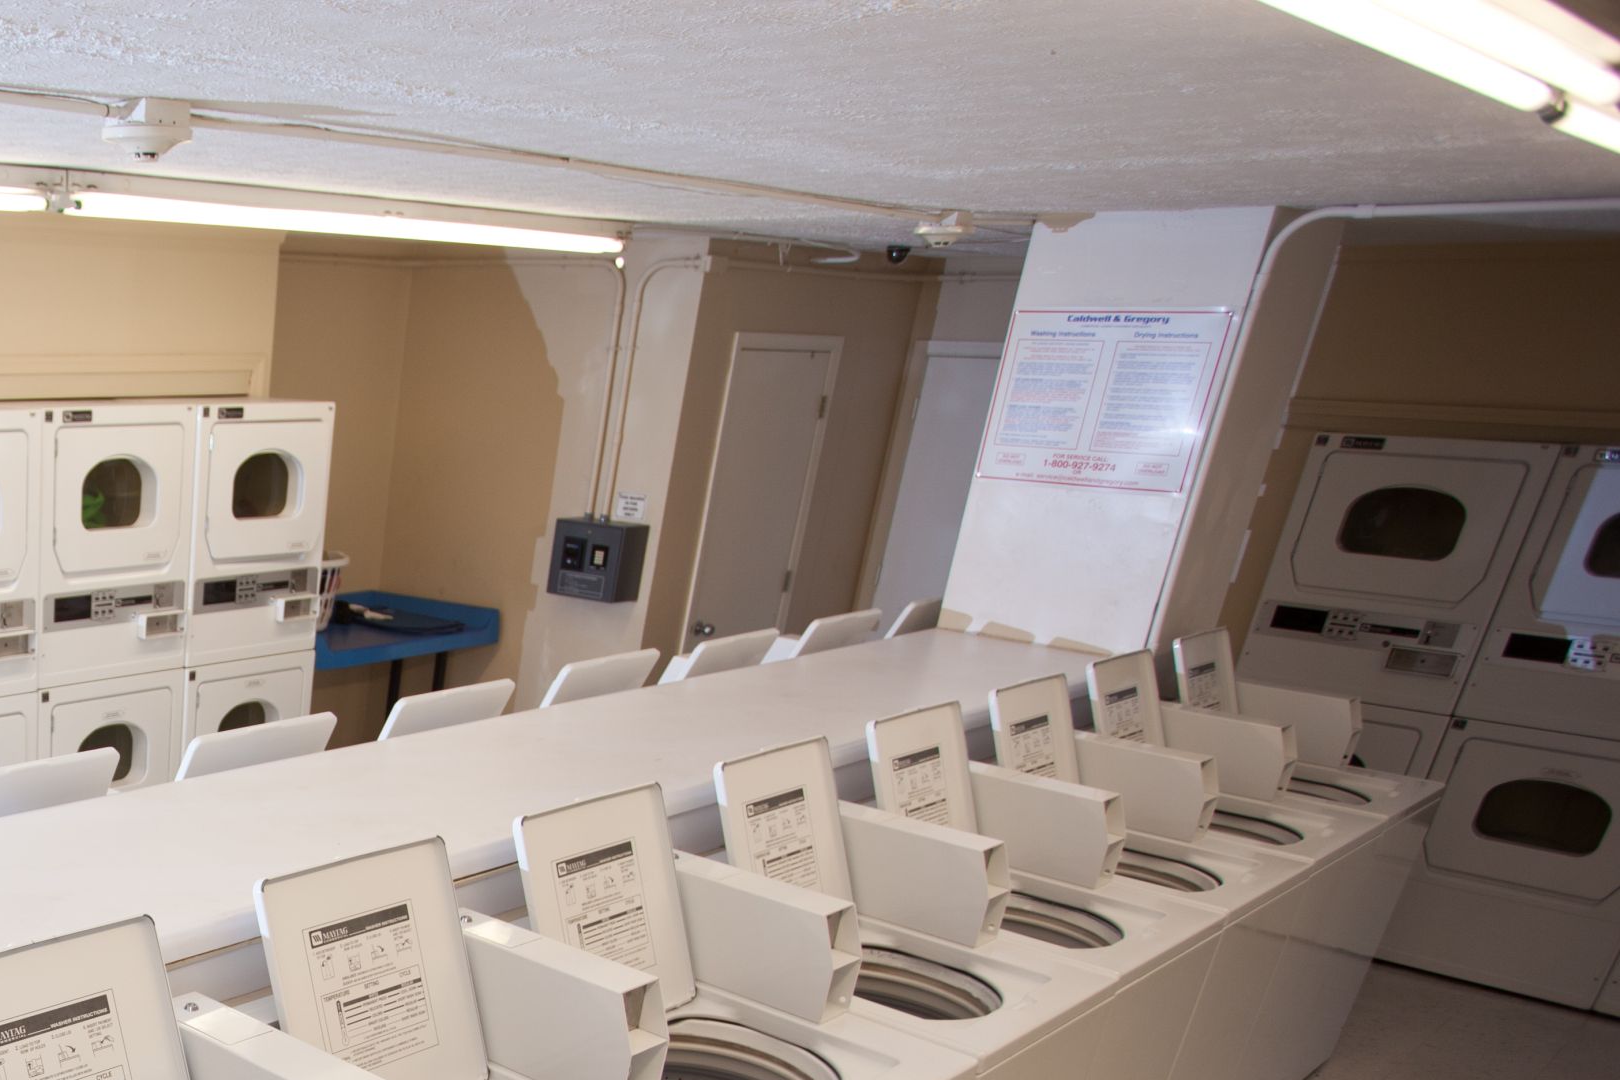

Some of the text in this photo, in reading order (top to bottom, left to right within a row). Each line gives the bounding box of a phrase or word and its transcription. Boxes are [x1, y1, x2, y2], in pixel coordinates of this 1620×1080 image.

[1066, 314, 1169, 324] Caldwell & Gregory
[1043, 458, 1116, 471] 1-800-927-9274
